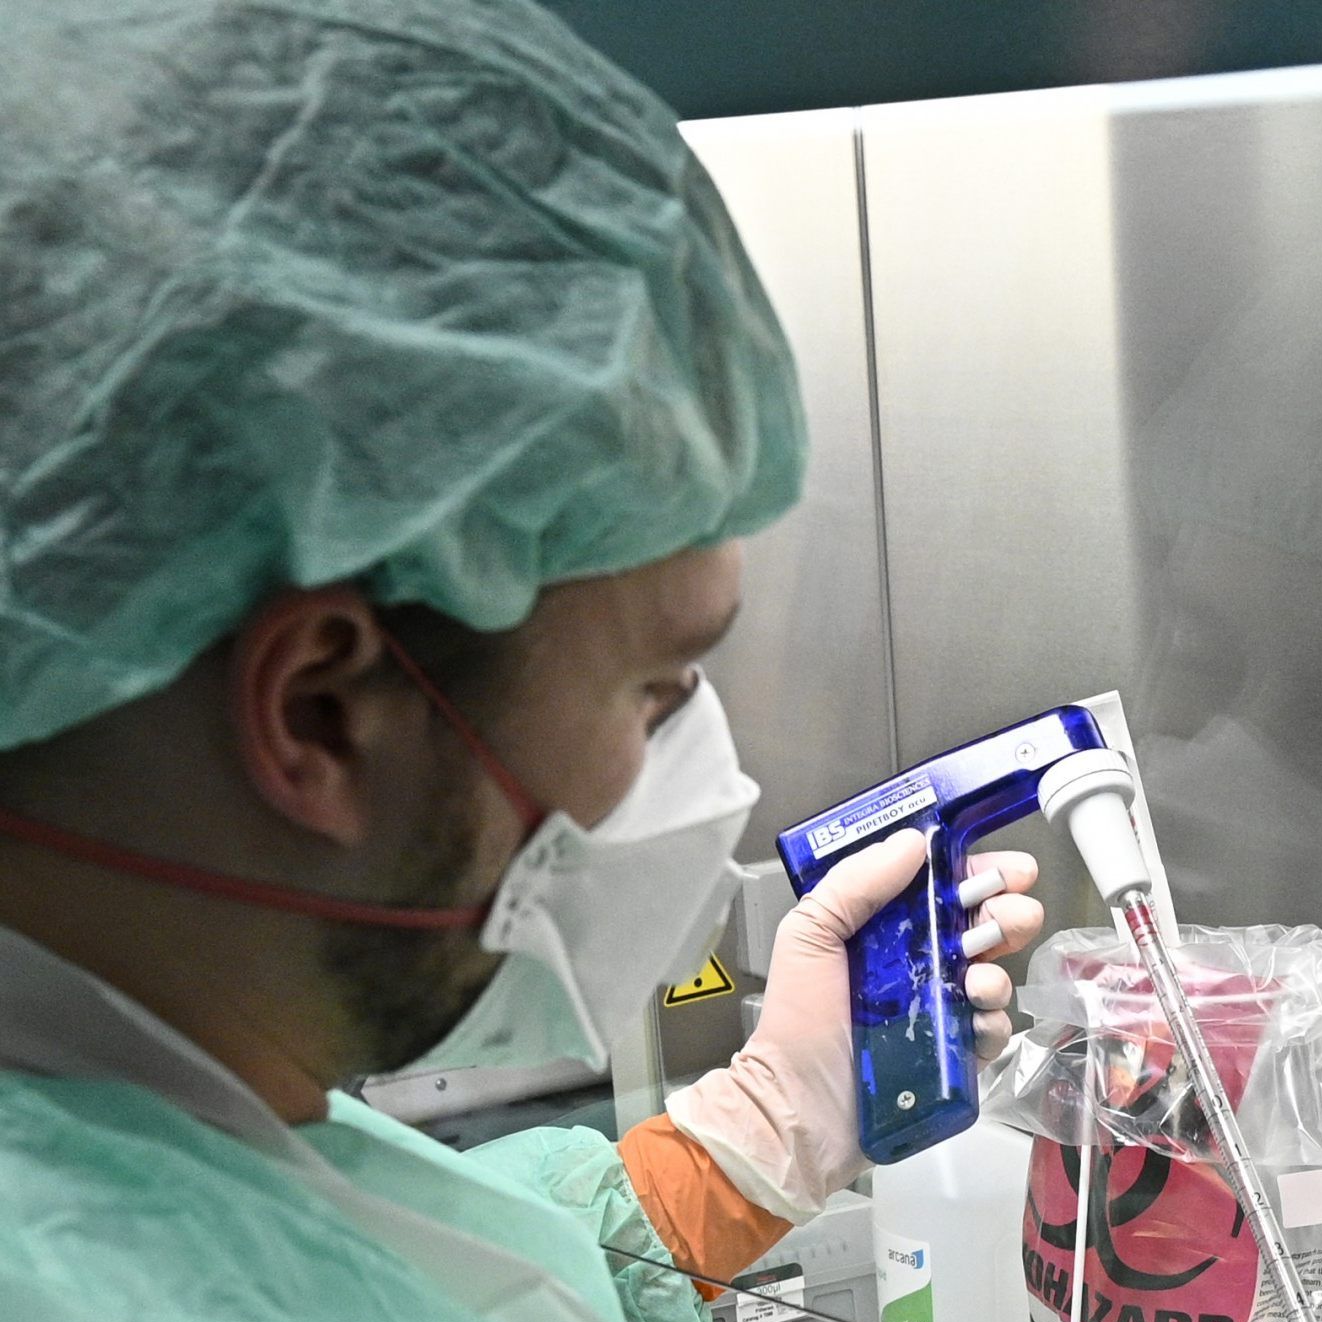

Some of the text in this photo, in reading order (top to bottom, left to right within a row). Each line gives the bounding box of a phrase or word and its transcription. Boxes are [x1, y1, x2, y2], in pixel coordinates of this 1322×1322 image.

[806, 820, 847, 852] IBS
[844, 799, 880, 825] INTEGRA
[856, 806, 904, 834] PIPETBOY
[888, 1248, 916, 1267] arcana
